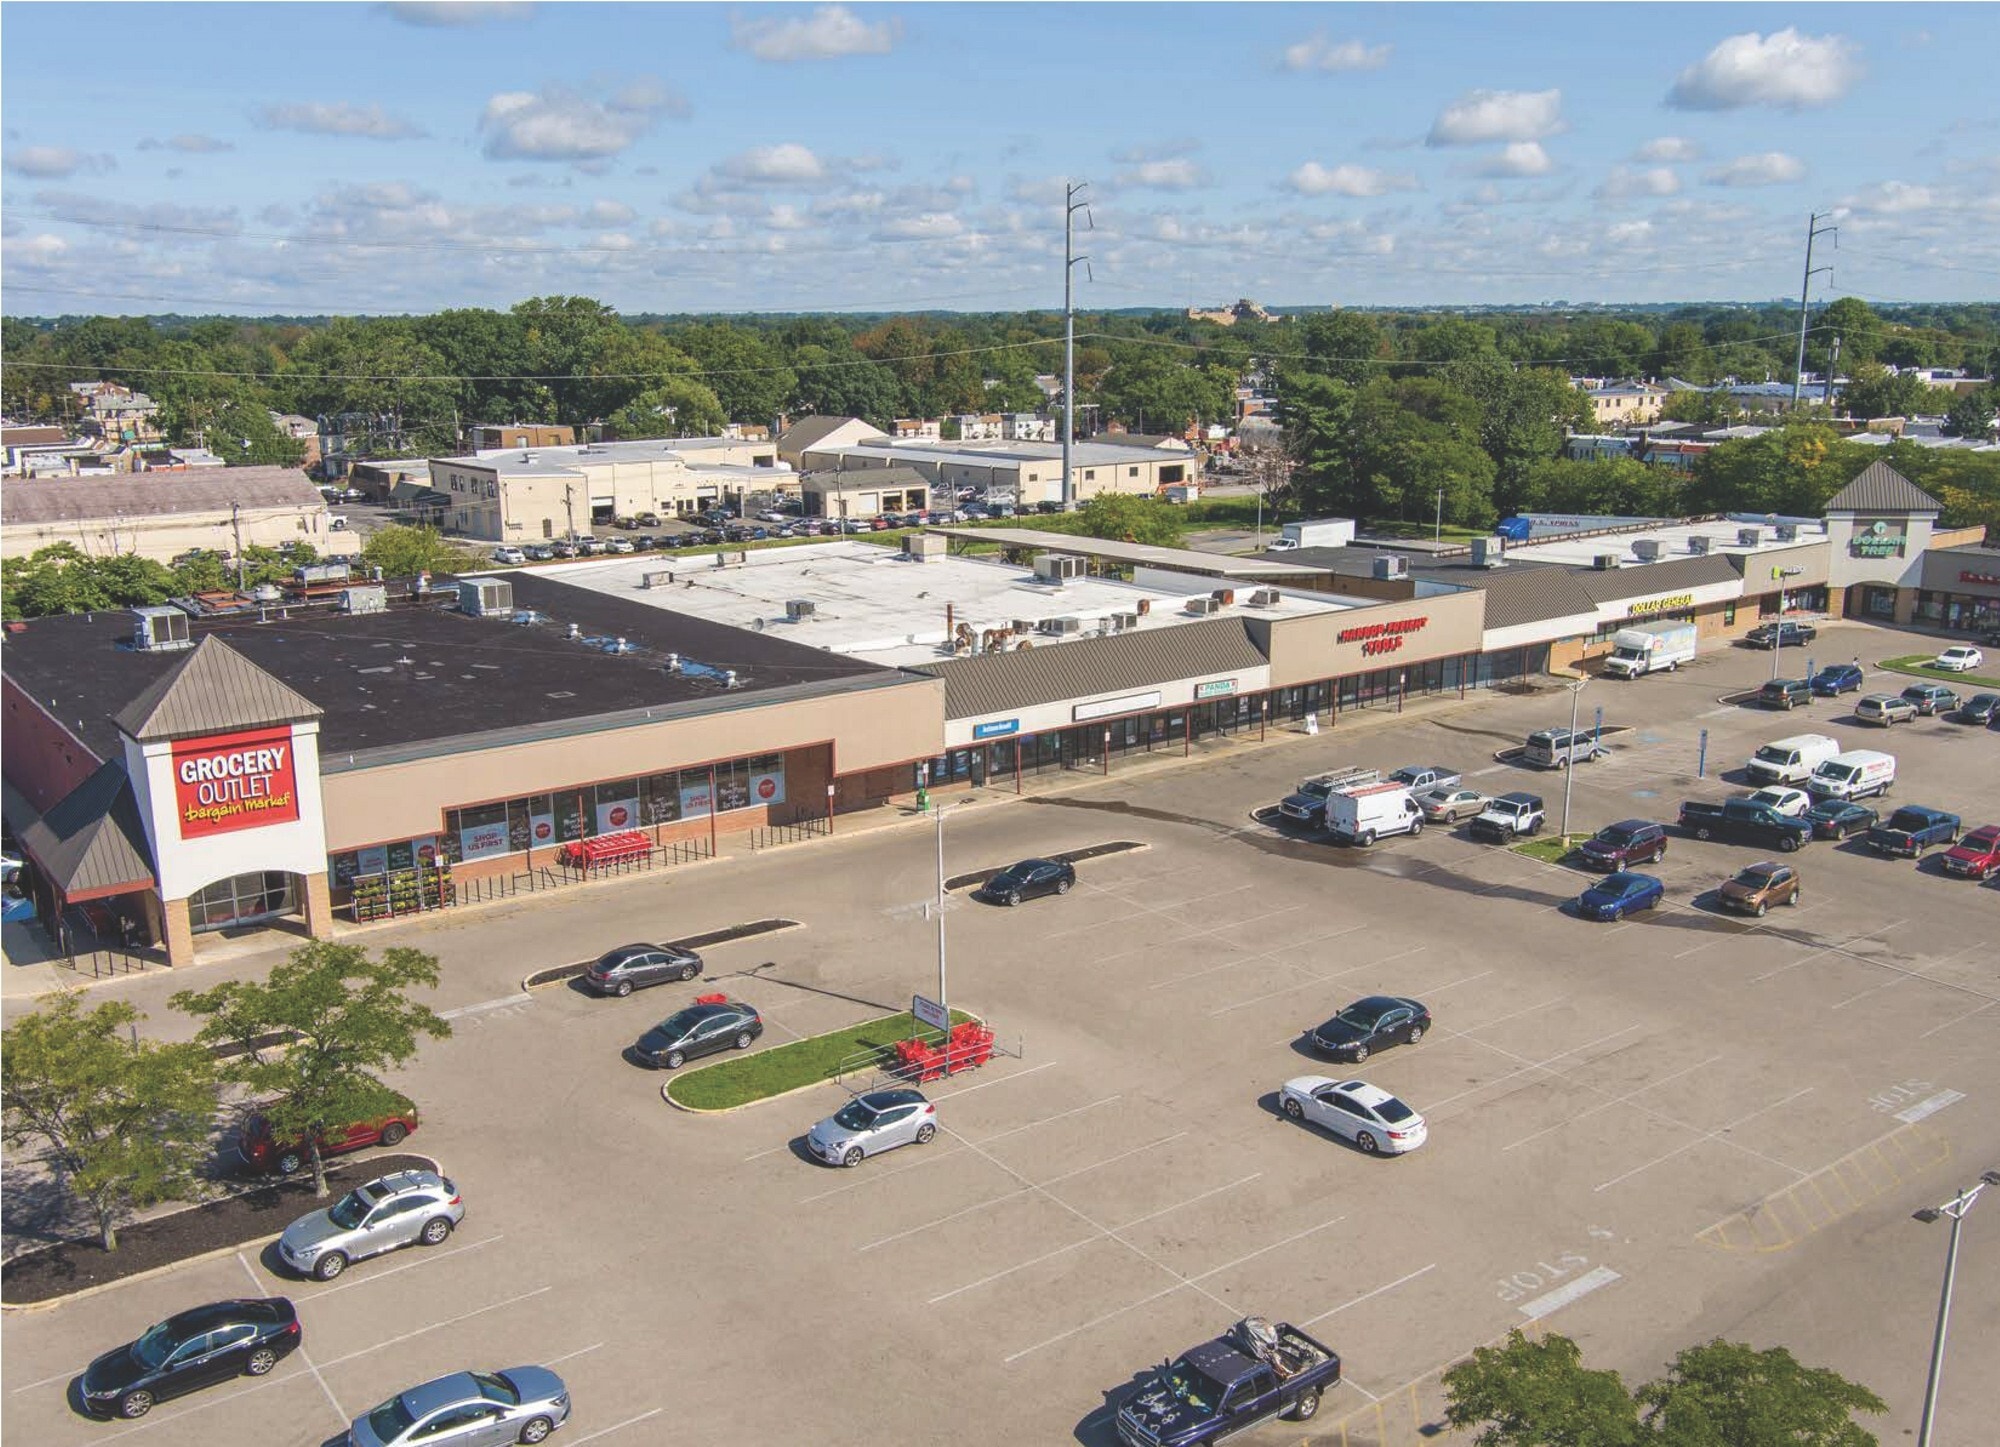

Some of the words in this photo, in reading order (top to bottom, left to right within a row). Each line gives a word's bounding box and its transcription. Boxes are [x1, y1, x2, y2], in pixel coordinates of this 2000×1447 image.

[1852, 535, 1907, 546] DOLLAR
[1860, 546, 1895, 556] TREE
[1632, 600, 1660, 614] DOLLAR
[1660, 593, 1694, 608] GENERAL
[1338, 622, 1385, 643] HARBOR
[1385, 616, 1428, 634] FREIGHT
[1365, 635, 1403, 656] TOOLS
[1204, 681, 1230, 691] PANDA
[180, 747, 286, 784] GROCERY
[198, 773, 273, 805] OUTLET
[184, 802, 242, 824] bargain
[244, 792, 290, 812] market
[467, 843, 480, 851] US
[480, 838, 503, 850] FIRST
[473, 832, 497, 841] SHOP
[1869, 1078, 1933, 1112] STOP
[1496, 1251, 1588, 1302] STOP
